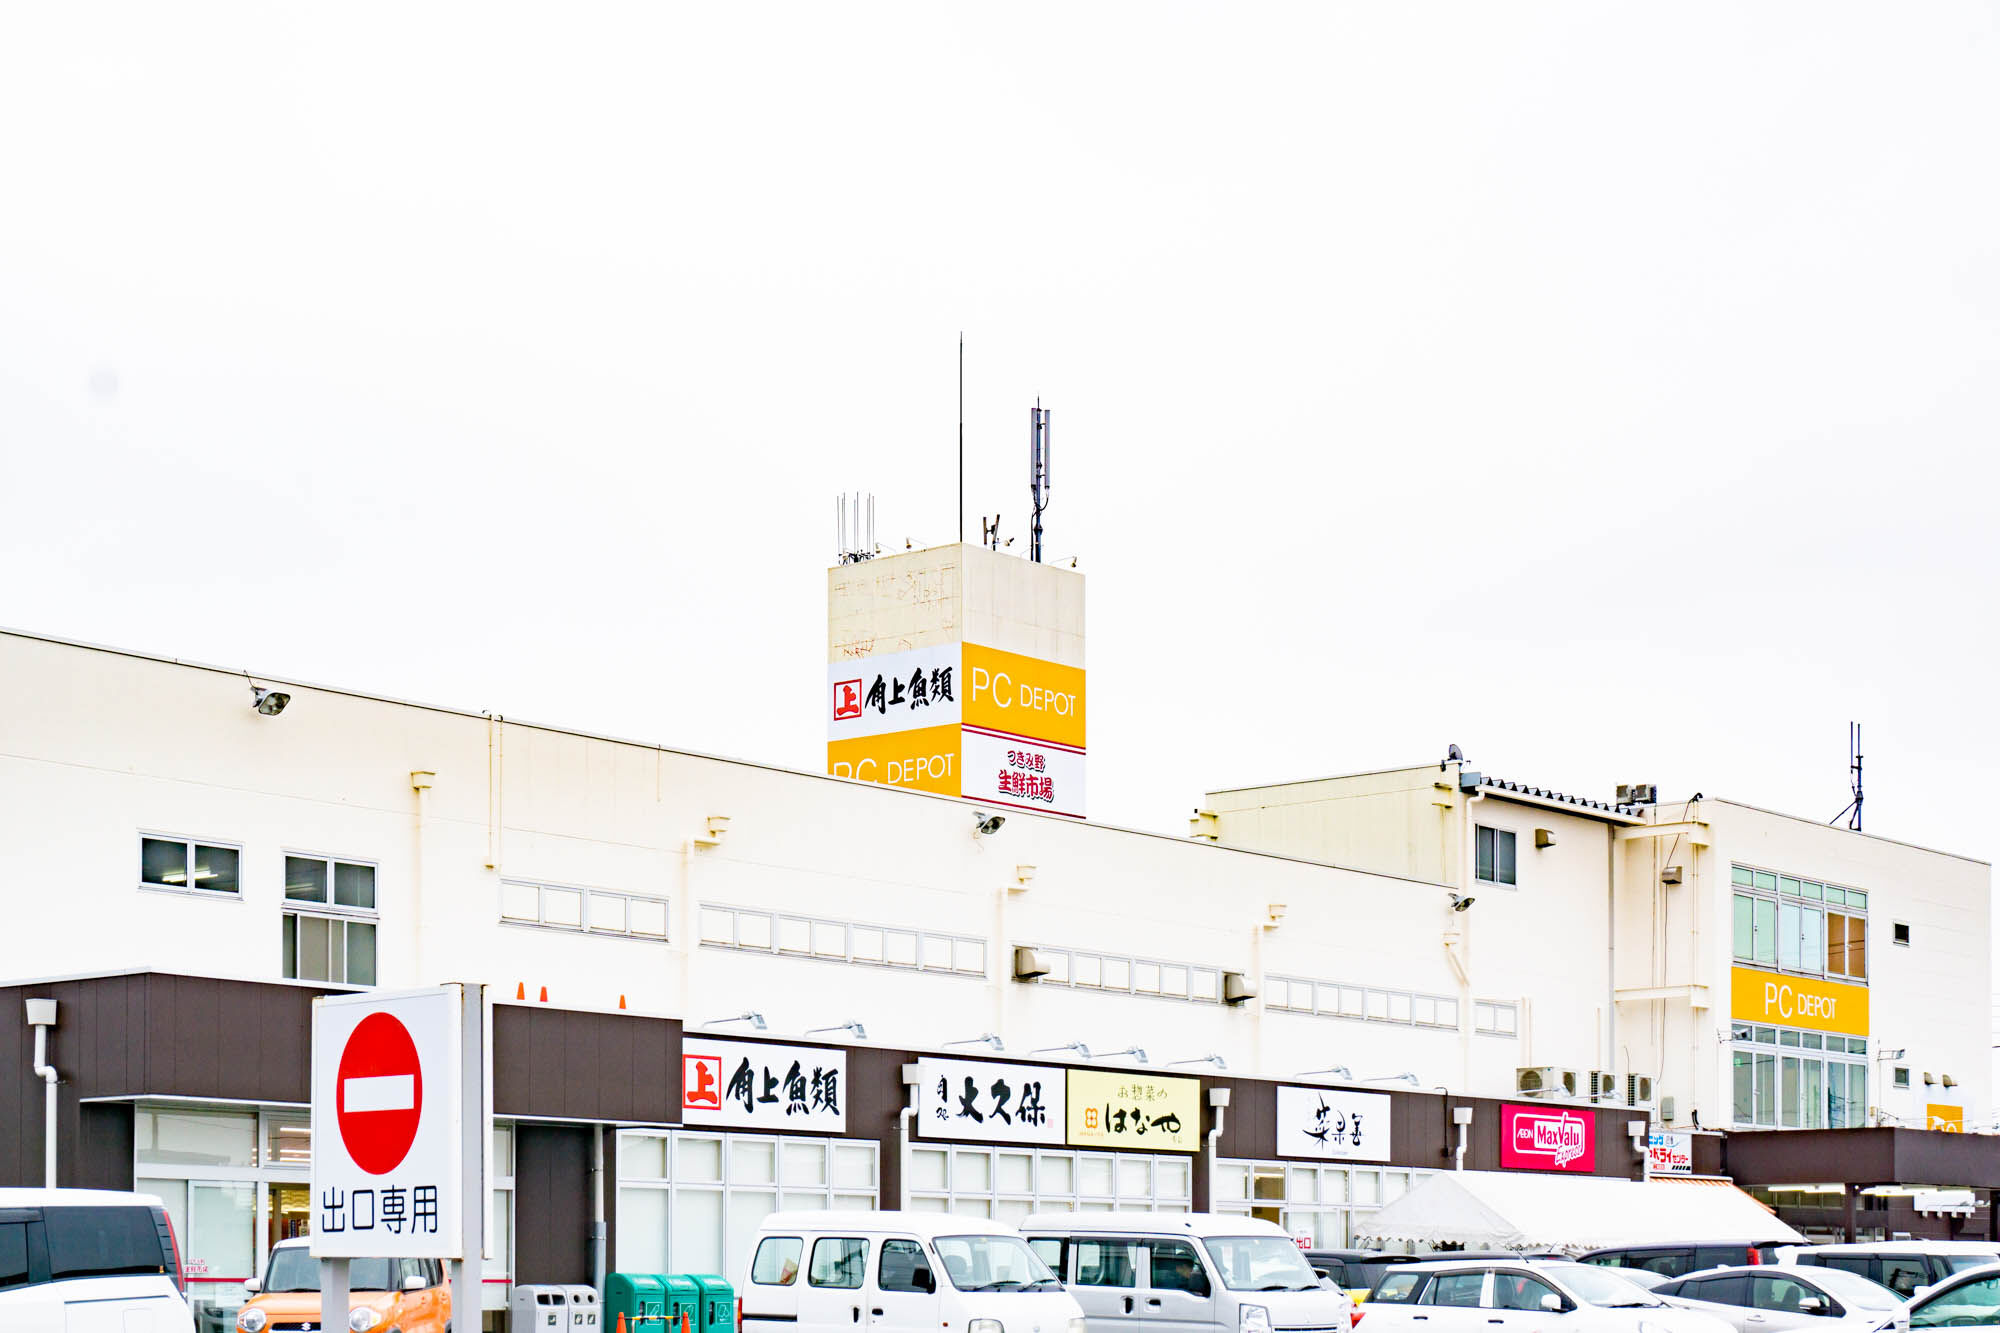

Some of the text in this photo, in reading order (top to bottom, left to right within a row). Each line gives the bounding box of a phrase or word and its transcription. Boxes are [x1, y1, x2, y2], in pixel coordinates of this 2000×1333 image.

[837, 667, 954, 716] 上 角上魚類
[973, 667, 1076, 717] PC DEPOT
[887, 753, 955, 784] DEPOT
[1008, 750, 1045, 772] つきみ野
[999, 769, 1054, 802] 生鮮市場
[1765, 982, 1837, 1019] PC DEPOT
[687, 1057, 840, 1116] 上 角上魚類
[957, 1076, 1046, 1127] 大久保
[1117, 1083, 1168, 1101] お惣菜の
[1105, 1102, 1181, 1135] はなや
[1537, 1112, 1580, 1147] MaxValu
[322, 1184, 438, 1234] 出口専用
